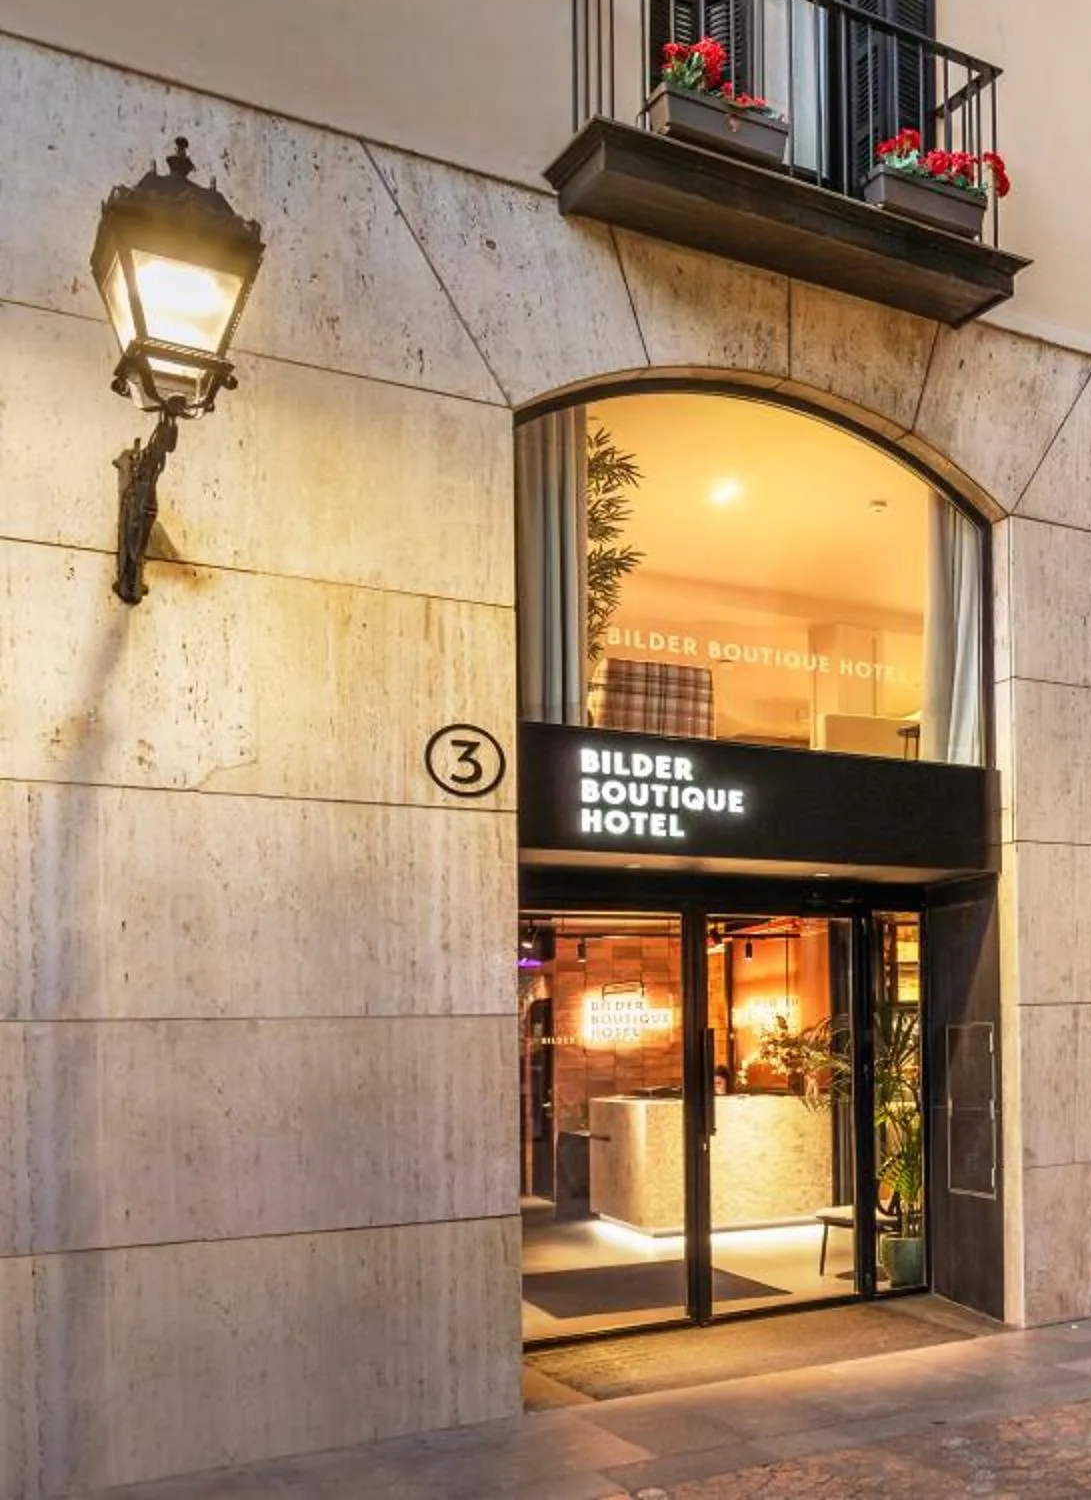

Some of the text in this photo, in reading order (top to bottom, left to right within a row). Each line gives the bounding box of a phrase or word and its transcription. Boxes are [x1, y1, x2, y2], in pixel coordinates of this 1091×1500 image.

[606, 627, 908, 684] BILDER BOUTIQUE HOTEL
[450, 740, 483, 784] 3
[580, 748, 694, 781] BILDER
[580, 778, 744, 813] BOUTIQUE
[580, 808, 685, 837] HOTEL
[590, 1000, 644, 1012] BILDER
[590, 1013, 670, 1025] BOUTIQUE
